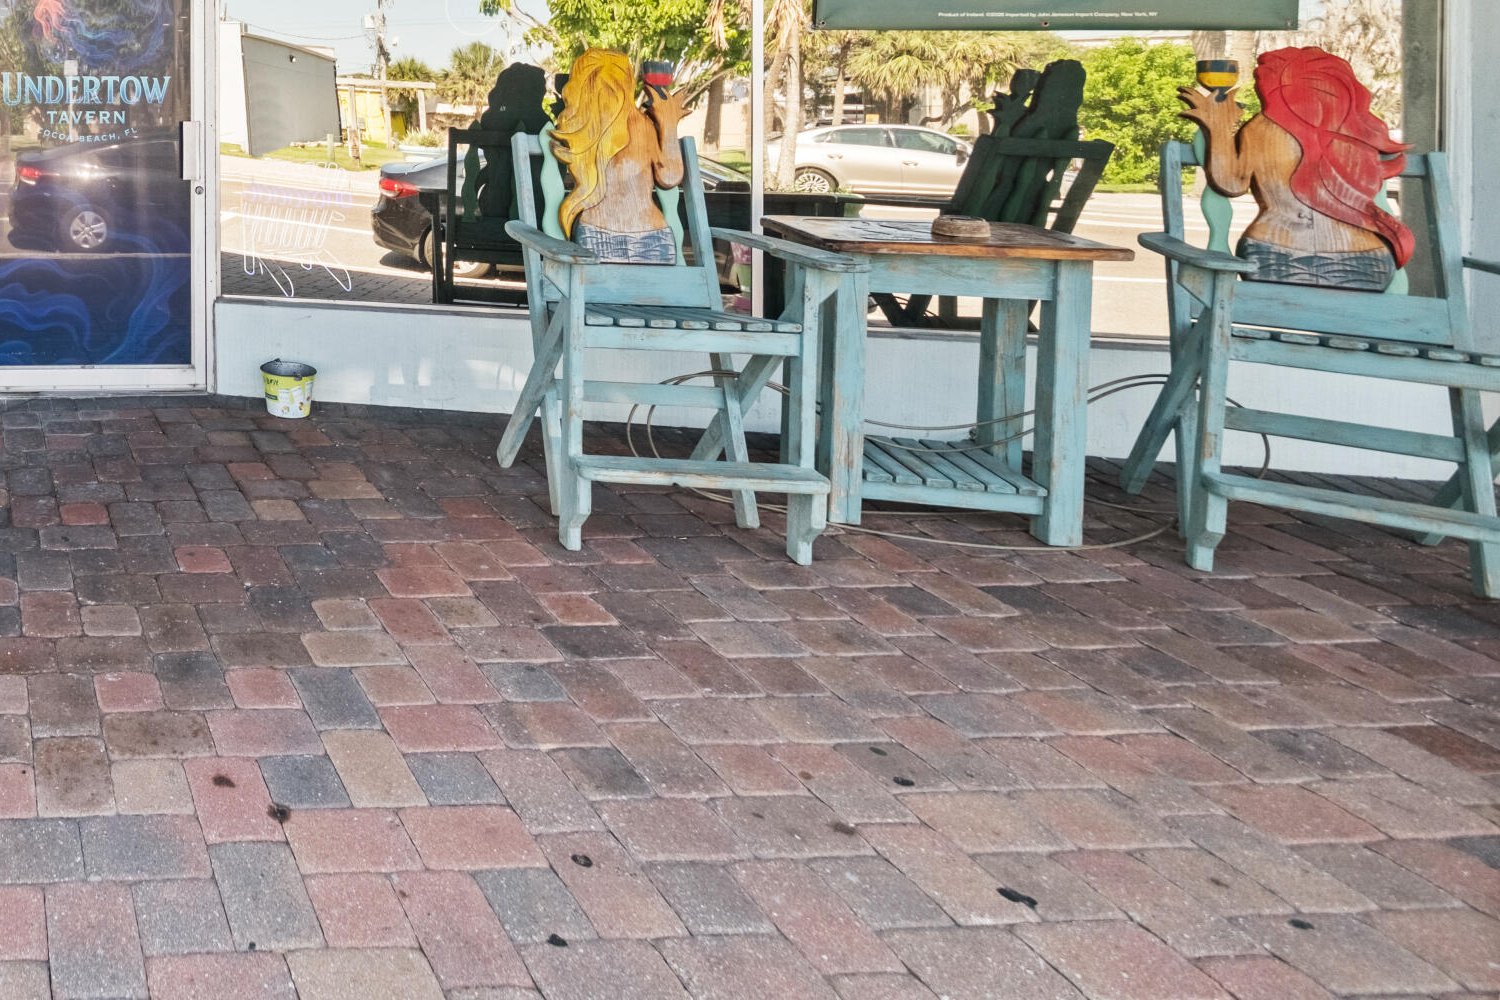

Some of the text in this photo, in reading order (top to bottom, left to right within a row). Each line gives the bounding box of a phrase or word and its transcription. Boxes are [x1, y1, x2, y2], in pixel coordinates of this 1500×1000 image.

[1, 71, 172, 107] UNDERTOW
[47, 110, 126, 125] TAVERN
[38, 127, 138, 143] COCOA BEACH, FL
